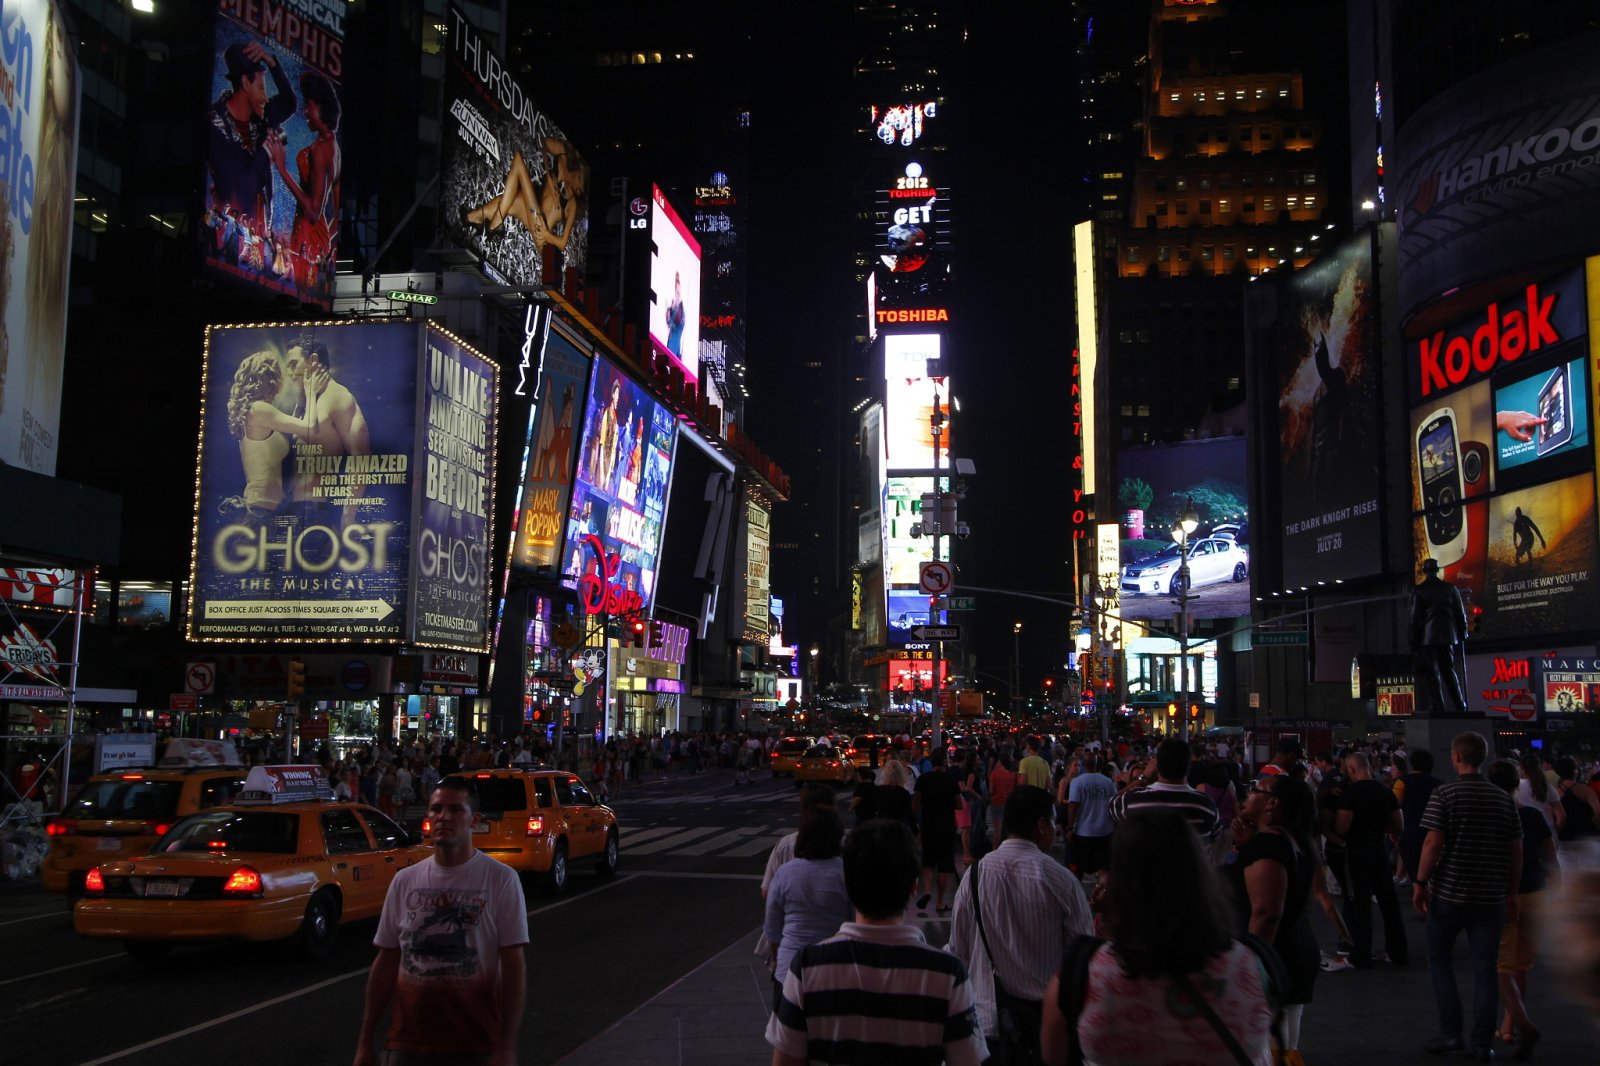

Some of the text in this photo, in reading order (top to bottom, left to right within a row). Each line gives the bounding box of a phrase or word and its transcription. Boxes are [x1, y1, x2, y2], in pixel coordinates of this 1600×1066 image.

[219, 0, 342, 76] MEMPHIS
[451, 7, 548, 148] THURSDAYS
[453, 101, 498, 155] RUNWAY
[889, 188, 936, 198] TOSHIBA
[897, 177, 928, 189] 2012
[1464, 170, 1532, 204] driving
[630, 219, 647, 229] LG
[894, 205, 932, 225] GET
[391, 293, 432, 303] LAMAR
[877, 308, 948, 323] TOSHIBA
[1419, 282, 1561, 397] Kodak
[429, 394, 486, 449] ANYTHING
[300, 445, 323, 455] WAS
[428, 430, 486, 474] SEEN ONSTAGE
[296, 454, 408, 474] TRULY AMAZED
[320, 473, 407, 486] FOR THE FIRST TIME
[312, 487, 322, 497] IN
[534, 488, 560, 512] MARY
[525, 510, 561, 537] POPPINS
[1285, 500, 1378, 536] THE DARK KNIGHT RISES
[213, 523, 395, 573] GHOST
[1316, 537, 1342, 554] JULY 20
[420, 528, 487, 588] GHOST
[239, 578, 365, 590] THE MUSICAL
[1497, 583, 1513, 593] BUILT
[1514, 581, 1525, 590] FOR
[1527, 579, 1538, 588] THE
[1539, 576, 1554, 587] WAY
[1555, 574, 1570, 585] YOU
[424, 612, 478, 632] TICKETMASTER.COM
[912, 651, 923, 659] THE
[1376, 677, 1415, 685] MARQUIS
[281, 771, 311, 780] WINNING
